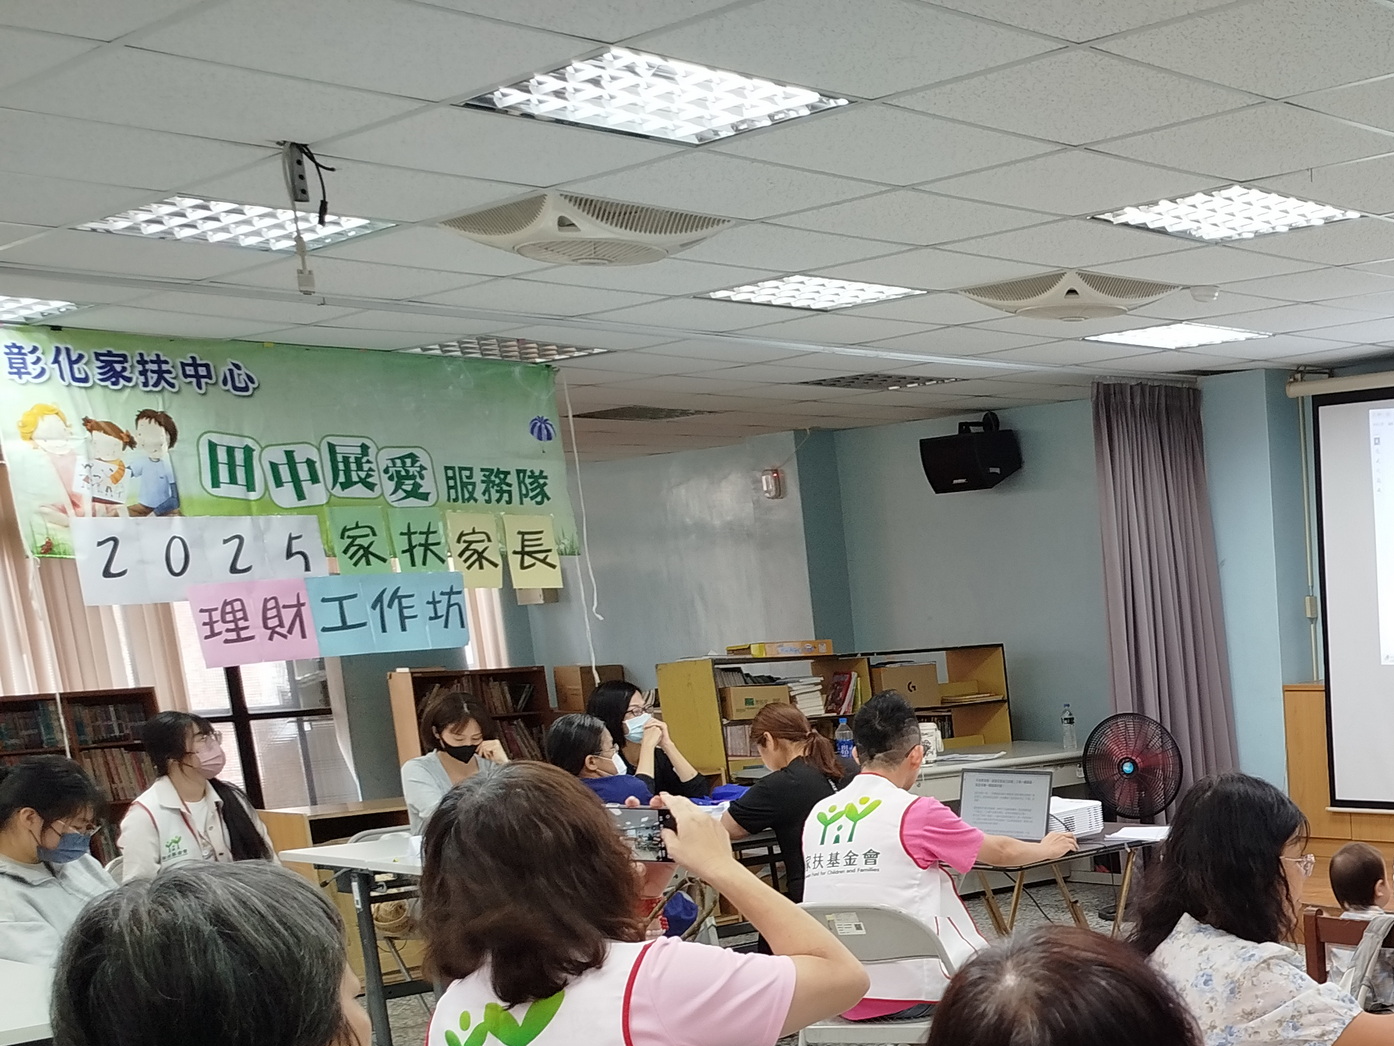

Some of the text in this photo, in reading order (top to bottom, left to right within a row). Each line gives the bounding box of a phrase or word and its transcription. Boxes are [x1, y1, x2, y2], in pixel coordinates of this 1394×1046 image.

[3, 341, 259, 397] 彰化家扶中心
[208, 434, 551, 508] 田中展愛 服務隊
[95, 520, 560, 578] 2025 家扶家長
[199, 583, 466, 645] 理財工作坊
